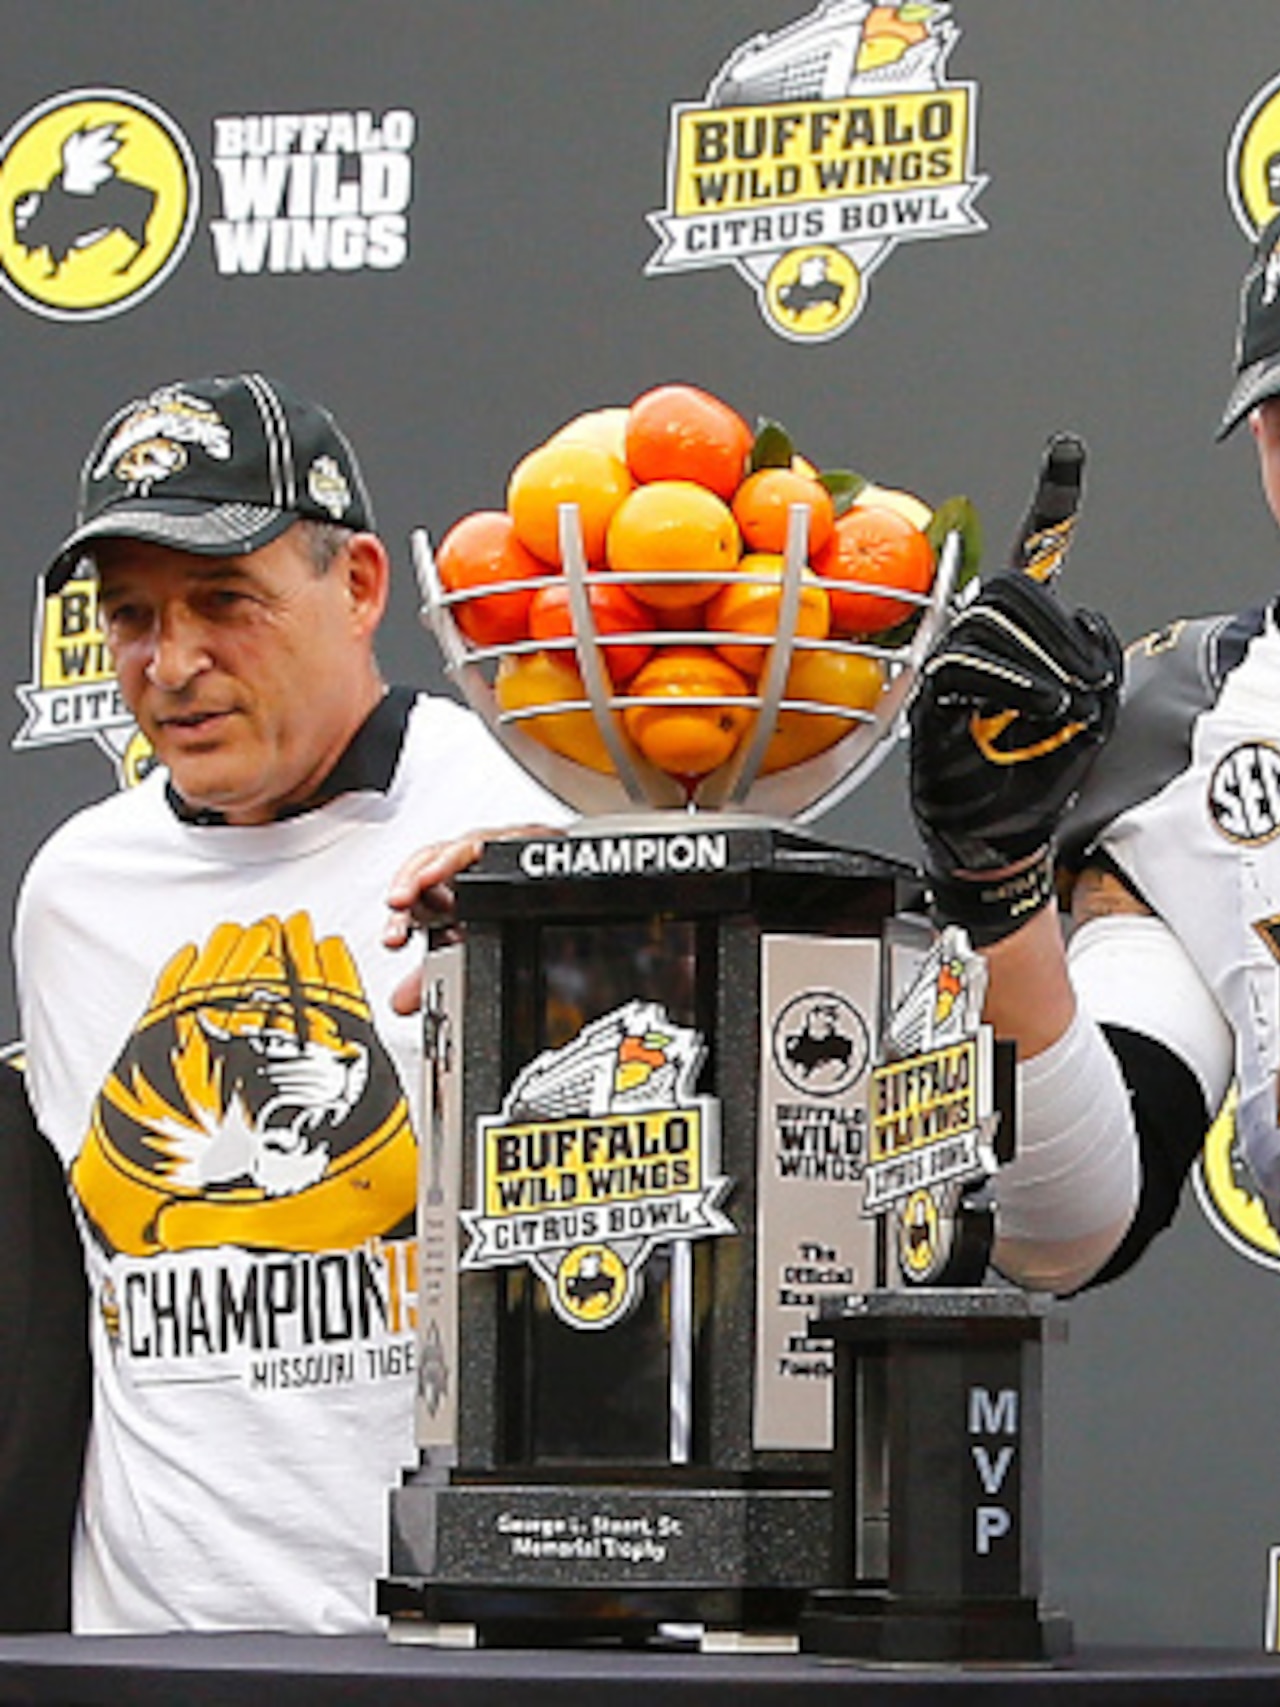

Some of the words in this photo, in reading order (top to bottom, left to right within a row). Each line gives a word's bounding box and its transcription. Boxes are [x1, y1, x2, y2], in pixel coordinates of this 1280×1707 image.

[213, 110, 415, 157] BUFFALO
[690, 100, 952, 166] BUFFALO
[213, 151, 411, 221] WILD
[692, 164, 800, 207] WILD
[815, 149, 952, 190] WINGS
[209, 214, 408, 274] WINGS
[685, 208, 825, 252] CITRUS
[840, 194, 949, 232] BOWL
[519, 835, 728, 878] CHAMPION
[496, 1117, 689, 1173] BUFFALO
[777, 1152, 862, 1181] WINGS
[779, 1124, 864, 1157] WILD
[497, 1173, 577, 1209] WILD
[587, 1160, 690, 1198] WINGS
[494, 1211, 599, 1250] CITRUS
[609, 1199, 690, 1233] BOWL
[251, 1353, 355, 1390] MISSOURI
[967, 1388, 1019, 1556] MVP
